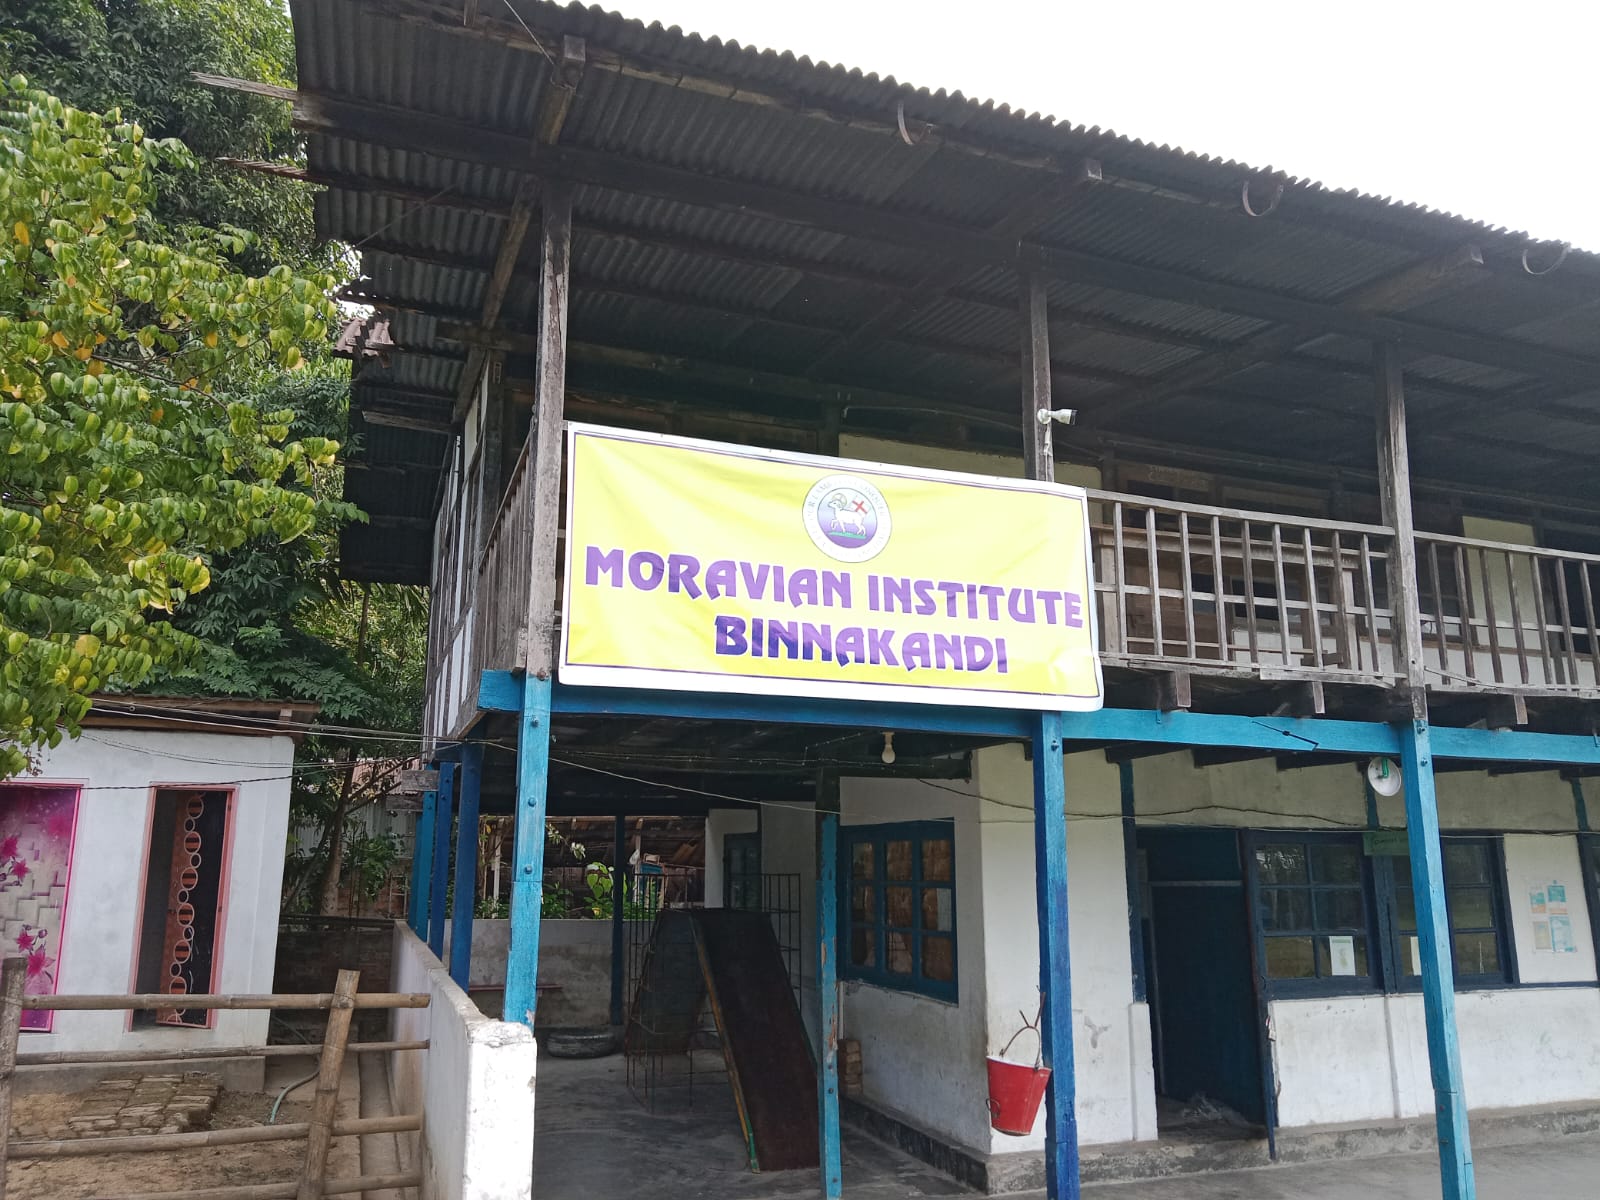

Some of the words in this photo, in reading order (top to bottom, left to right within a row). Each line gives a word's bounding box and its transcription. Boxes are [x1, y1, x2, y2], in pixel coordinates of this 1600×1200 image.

[586, 546, 851, 608] MORAVIAN
[868, 574, 1083, 628] INSTITUTE
[715, 615, 1007, 673] BINNAKANDI
